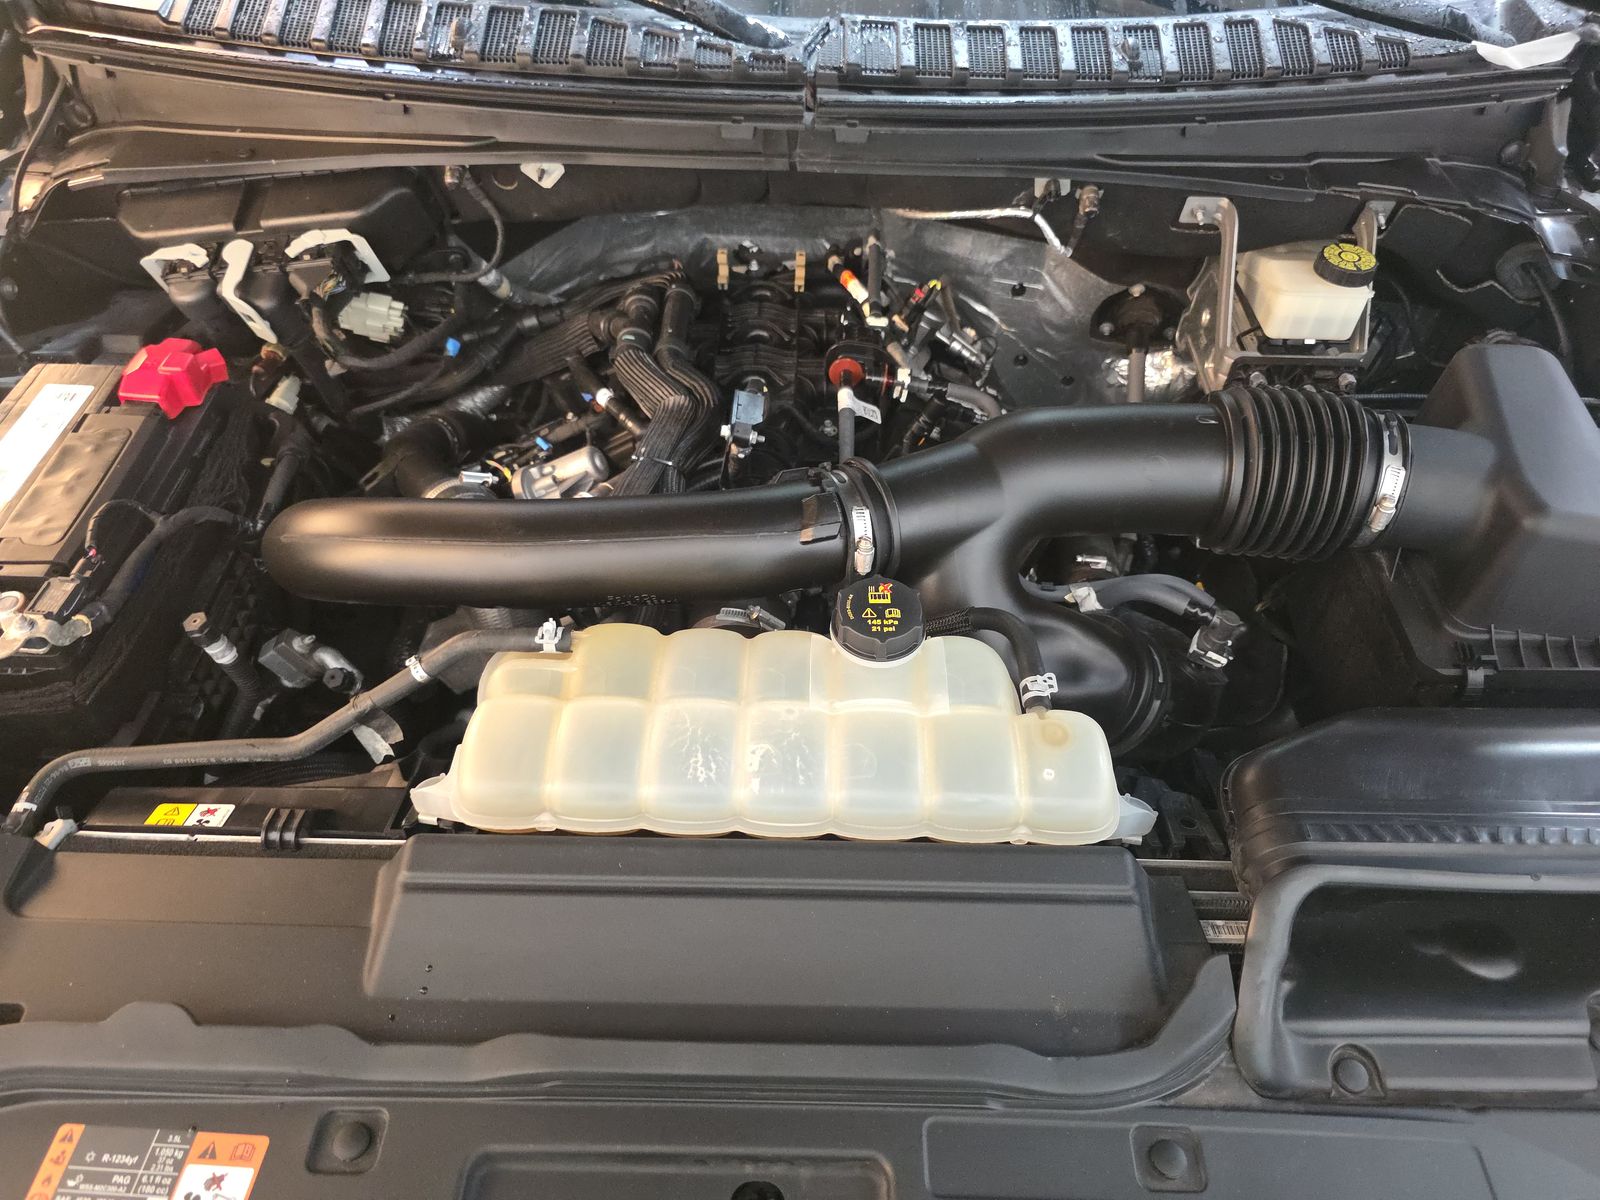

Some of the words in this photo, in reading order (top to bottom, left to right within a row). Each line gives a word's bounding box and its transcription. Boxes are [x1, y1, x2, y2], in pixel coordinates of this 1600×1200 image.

[102, 1152, 139, 1167] R-1234yf
[174, 1149, 184, 1160] kg
[112, 1174, 131, 1185] PAG
[161, 1177, 172, 1185] oz
